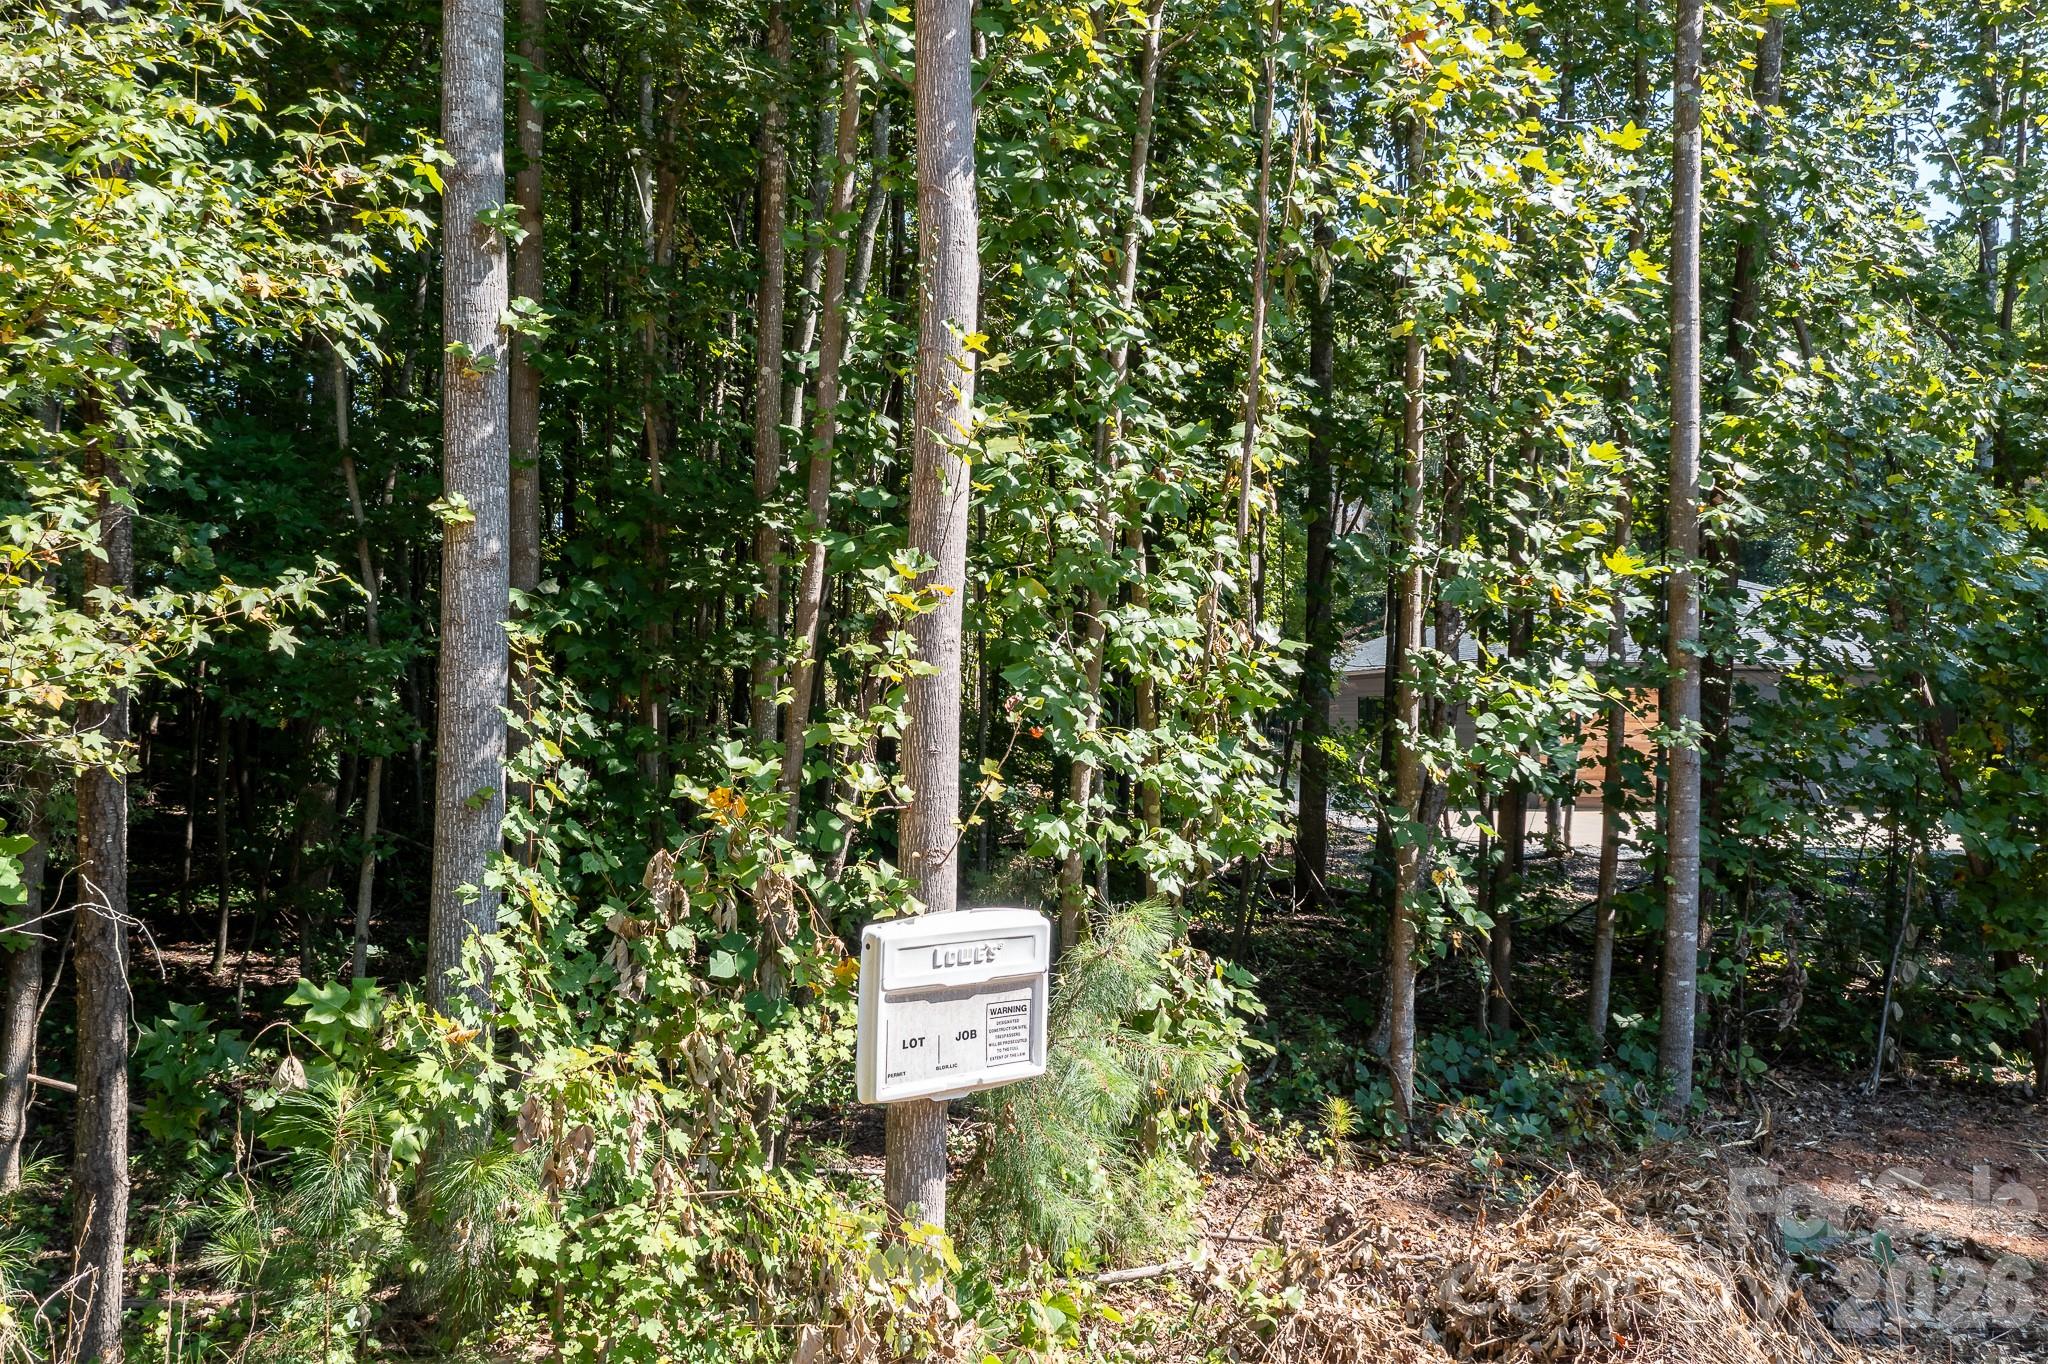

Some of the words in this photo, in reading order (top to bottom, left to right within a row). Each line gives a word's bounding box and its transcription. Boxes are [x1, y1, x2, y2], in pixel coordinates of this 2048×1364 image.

[989, 1004, 1028, 1016] WARNING
[955, 1028, 978, 1042] JOB
[902, 1036, 926, 1050] LOT
[887, 1071, 906, 1079] PERMIT
